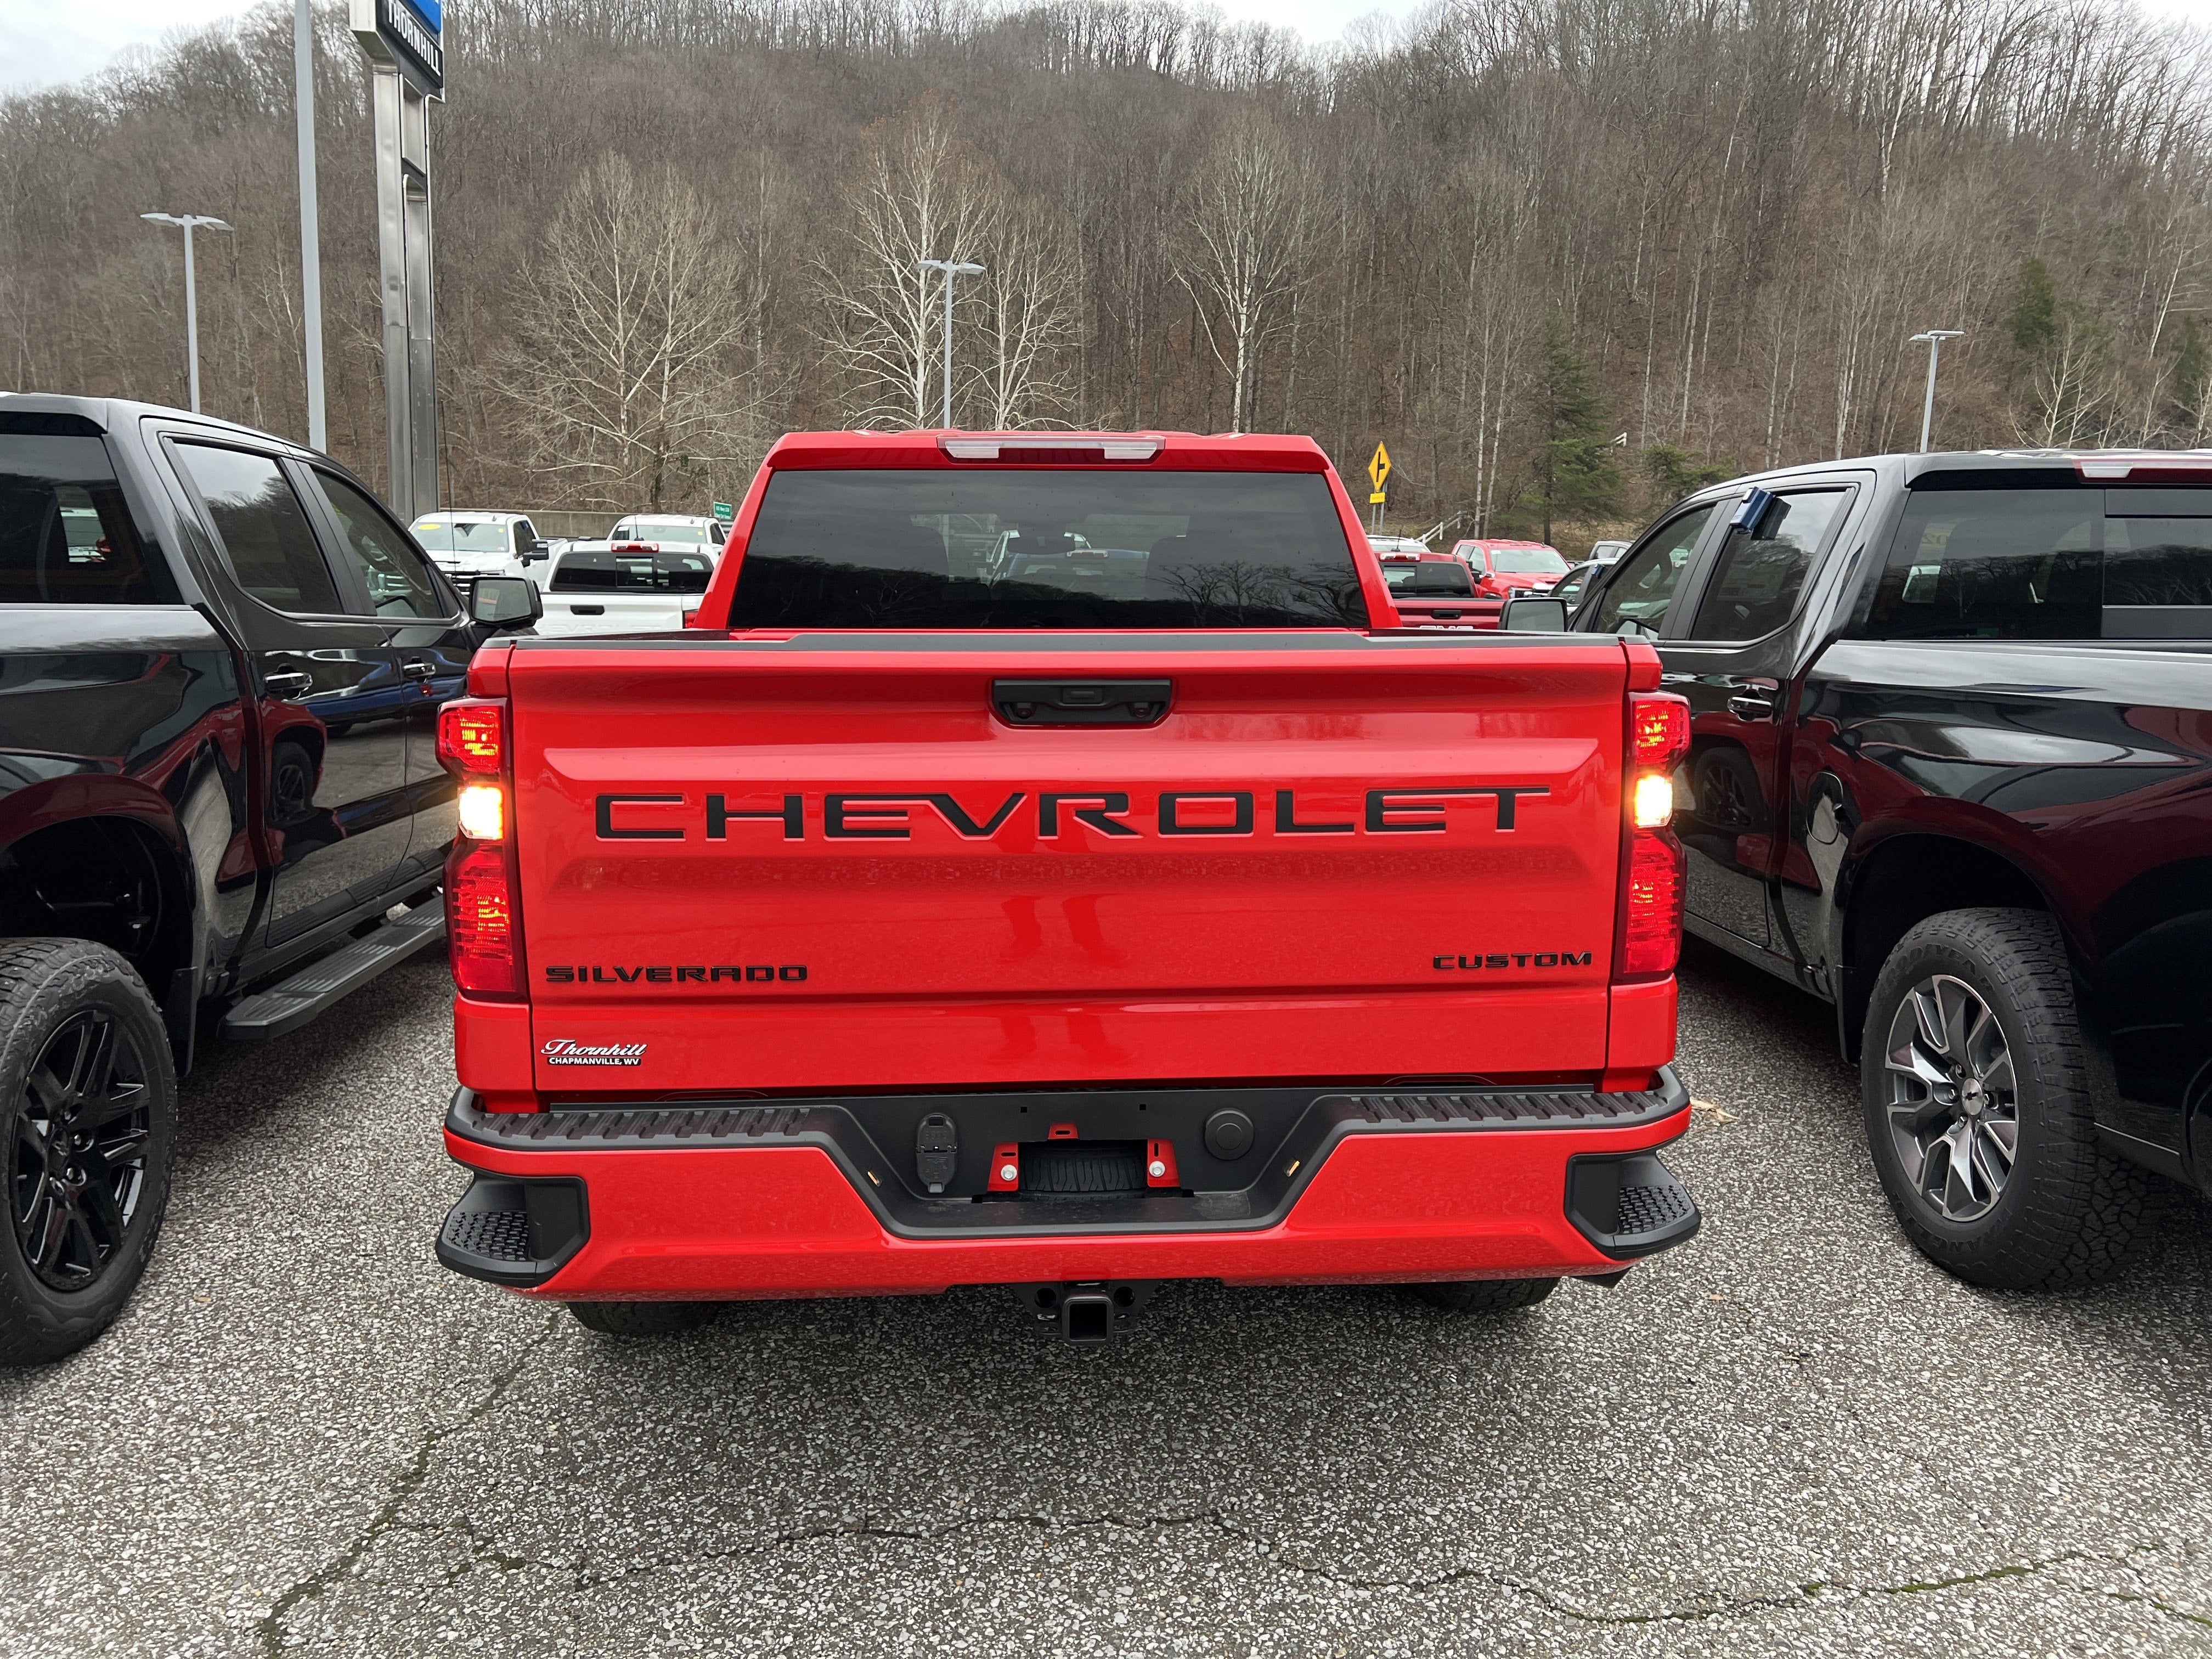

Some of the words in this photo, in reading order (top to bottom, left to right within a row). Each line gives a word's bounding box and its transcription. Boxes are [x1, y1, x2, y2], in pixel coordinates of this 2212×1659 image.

[387, 0, 441, 76] THORNHILL
[595, 786, 1551, 842] CHEVROLET
[1432, 951, 1592, 969] CUSTOM
[545, 965, 808, 982] SILVERADO
[540, 1039, 648, 1056] Thornhill
[549, 1057, 623, 1065] CHAPMANVILLE,
